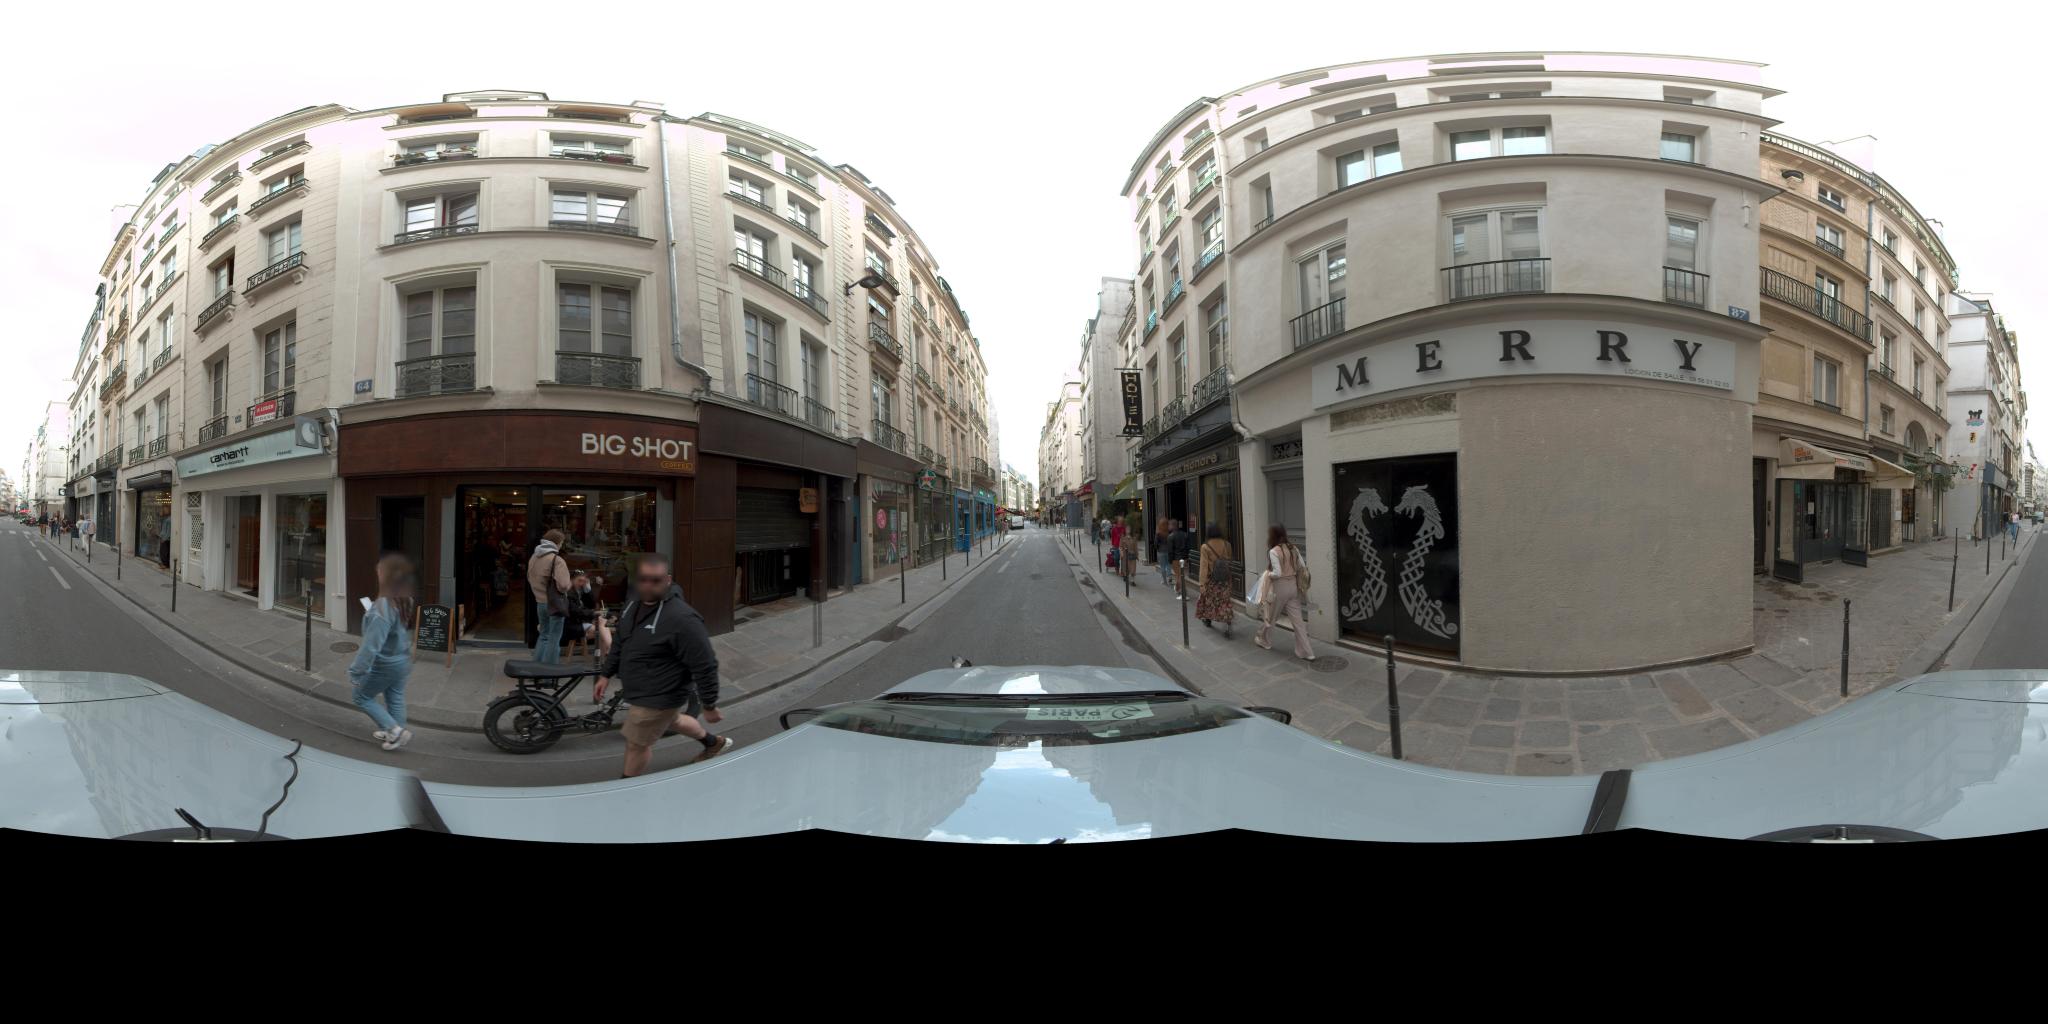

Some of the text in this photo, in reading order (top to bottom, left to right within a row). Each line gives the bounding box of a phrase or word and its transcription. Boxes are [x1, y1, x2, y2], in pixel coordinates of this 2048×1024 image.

[1731, 308, 1747, 319] 87
[1335, 330, 1702, 391] MERRY
[356, 381, 370, 392] 64
[581, 433, 692, 460] BIG SHOT
[210, 446, 248, 463] carhartt
[1038, 708, 1101, 716] PARIS
